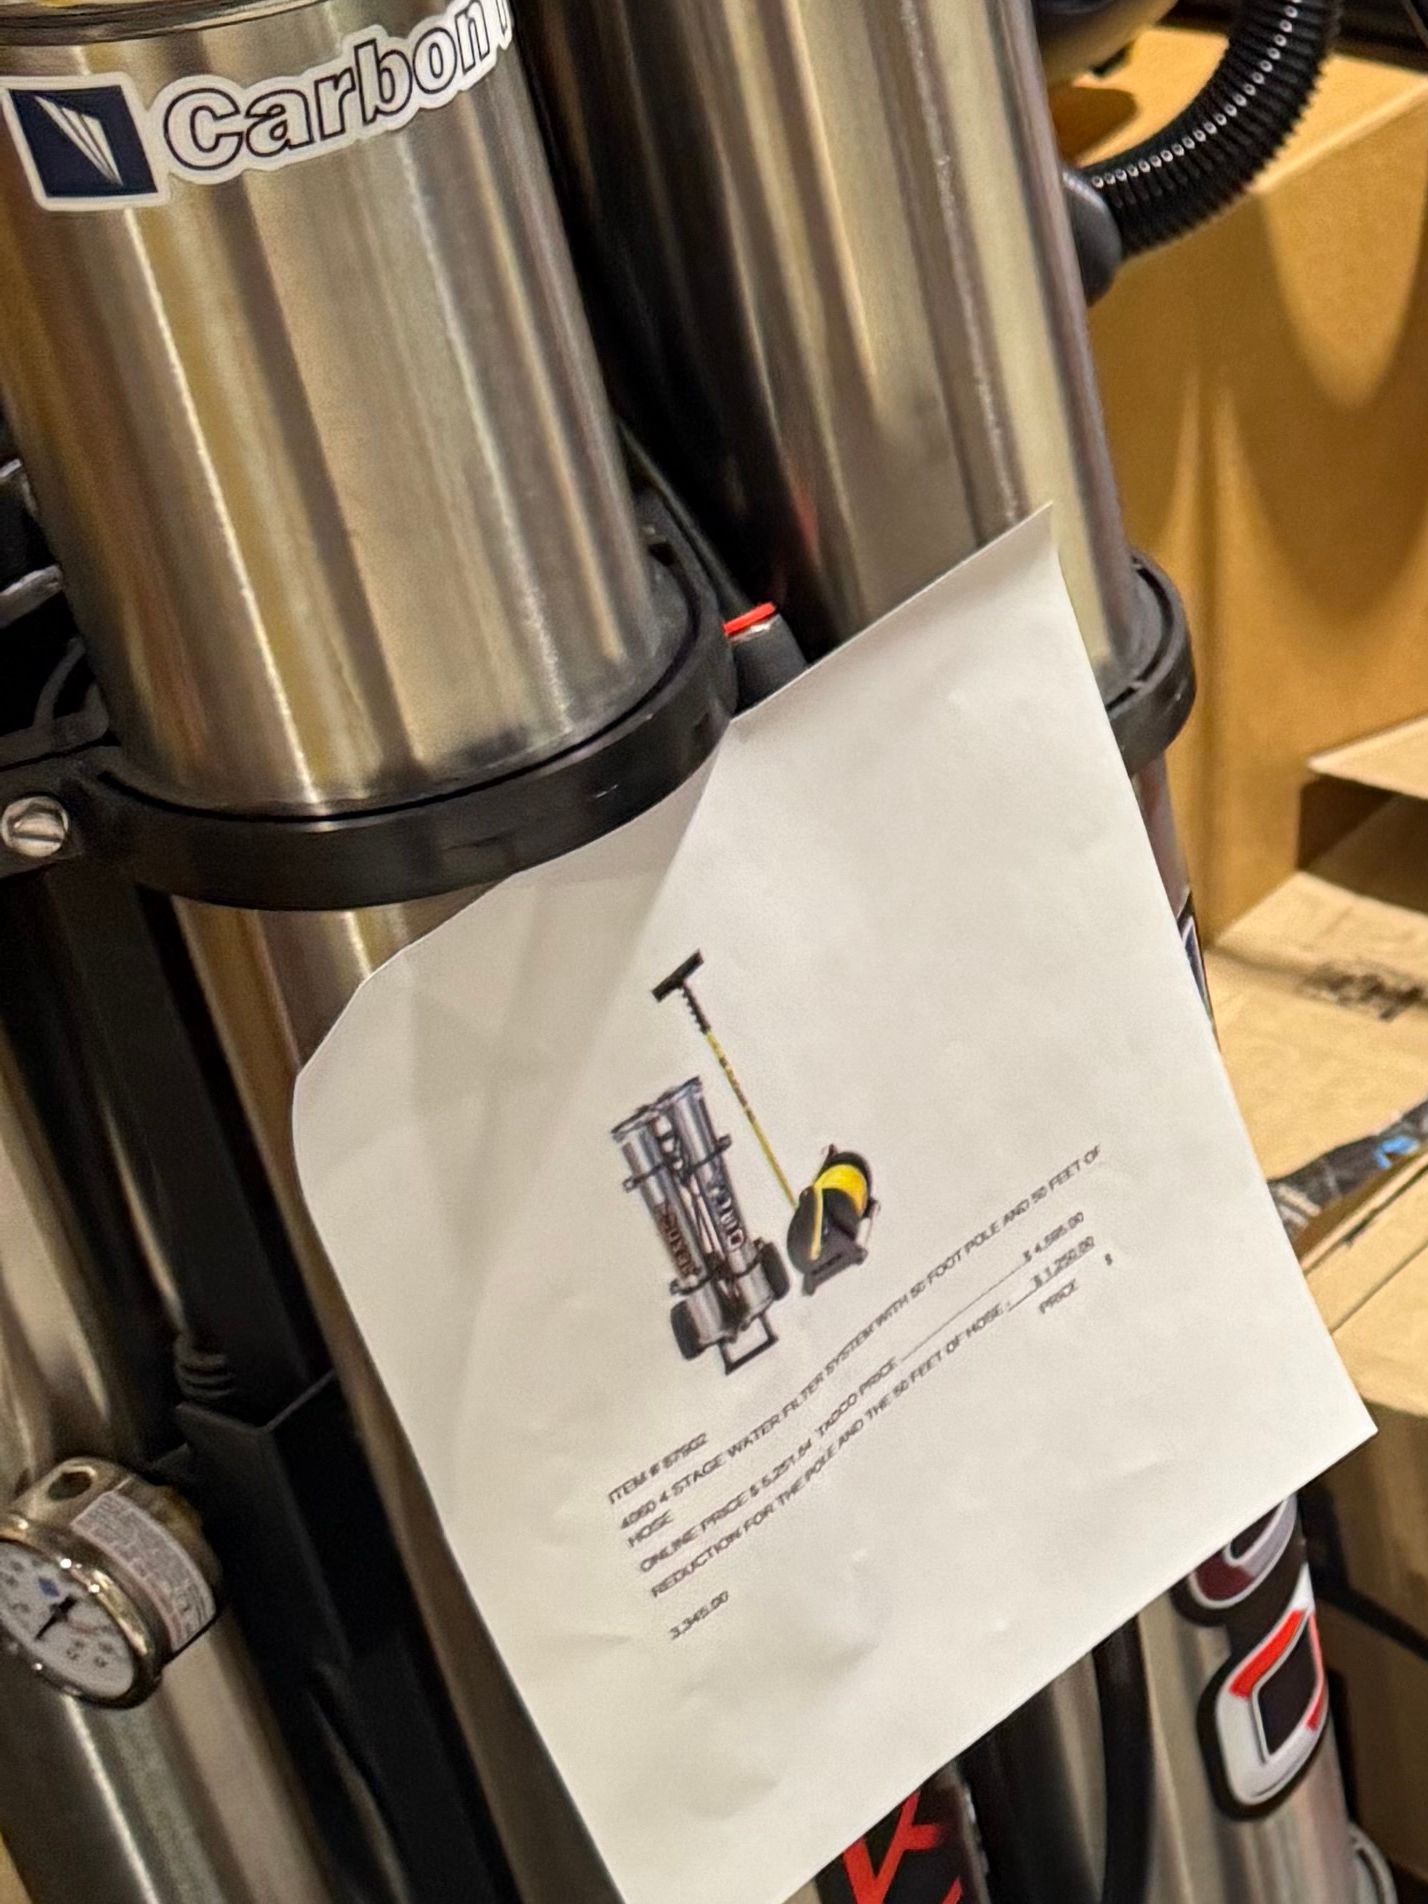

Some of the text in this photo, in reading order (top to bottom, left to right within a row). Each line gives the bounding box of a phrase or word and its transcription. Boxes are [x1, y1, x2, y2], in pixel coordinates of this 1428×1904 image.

[671, 1452, 726, 1496] STAGE
[726, 1413, 781, 1458] WATER
[781, 1371, 824, 1418] FILTER
[925, 1248, 961, 1285] FOOT
[963, 1221, 1000, 1254] POLE
[1048, 1159, 1080, 1191] FEET
[650, 1526, 742, 1598] REDUCTION
[743, 1502, 774, 1533] FOR
[804, 1443, 836, 1483] POLE
[838, 1418, 864, 1450] AND
[908, 1350, 942, 1383] FEET
[699, 1491, 748, 1533] PRICE
